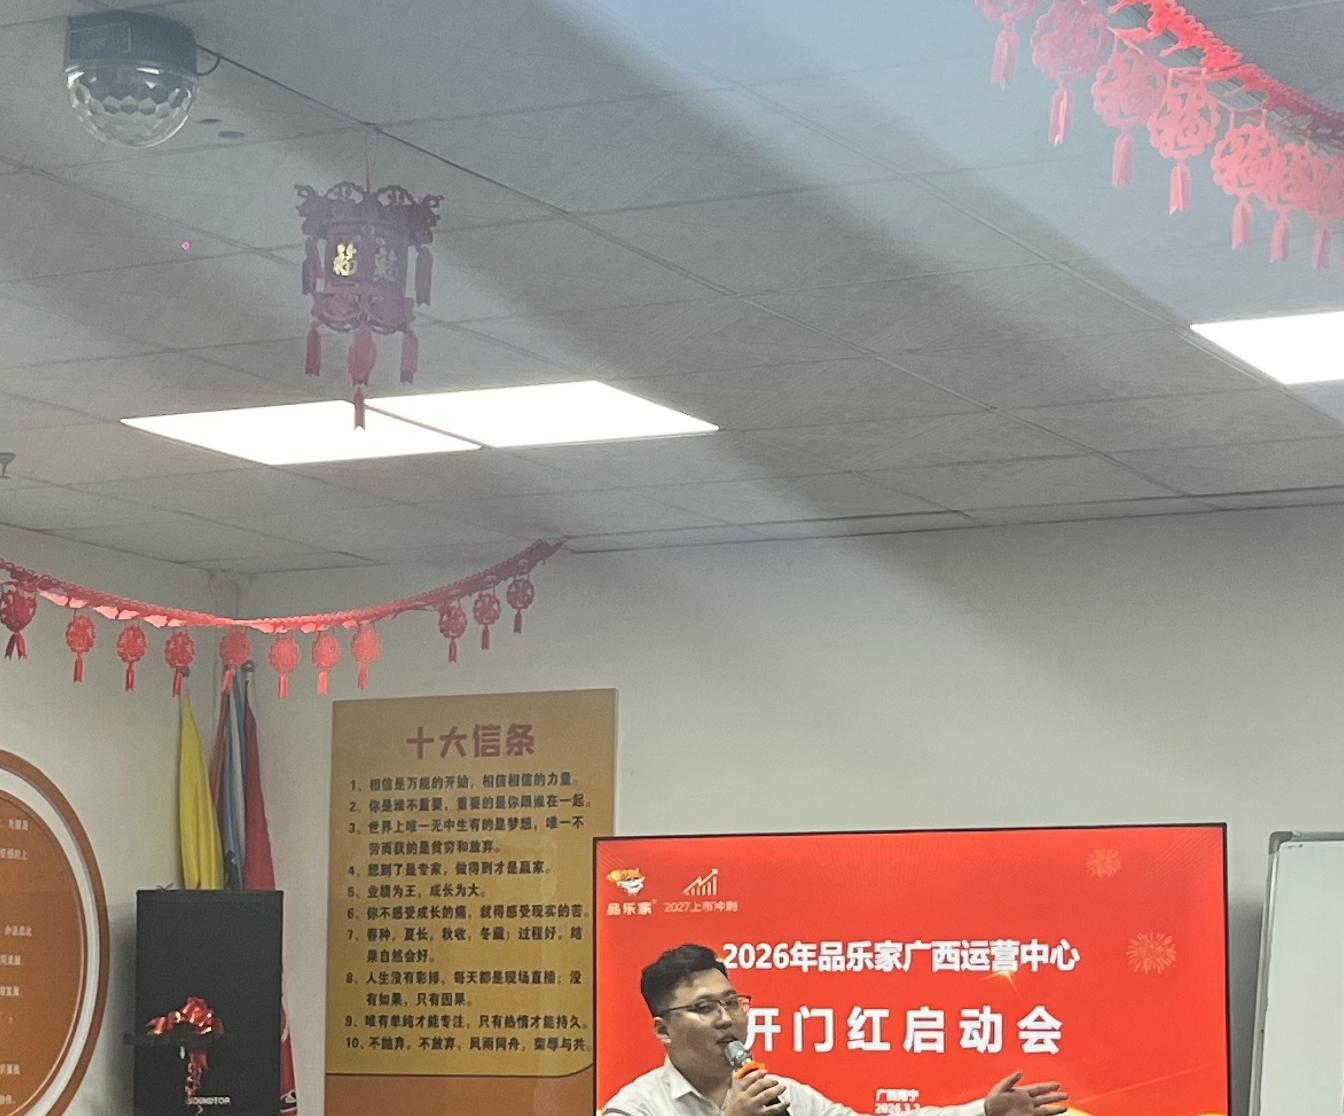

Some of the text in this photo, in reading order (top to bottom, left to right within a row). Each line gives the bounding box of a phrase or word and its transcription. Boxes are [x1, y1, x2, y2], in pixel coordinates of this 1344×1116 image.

[407, 723, 536, 759] 十大信条
[607, 901, 653, 916] 品乐家
[722, 939, 1080, 973] 2026年品乐家广西运营中心
[745, 1004, 1063, 1054] 开门红启动会
